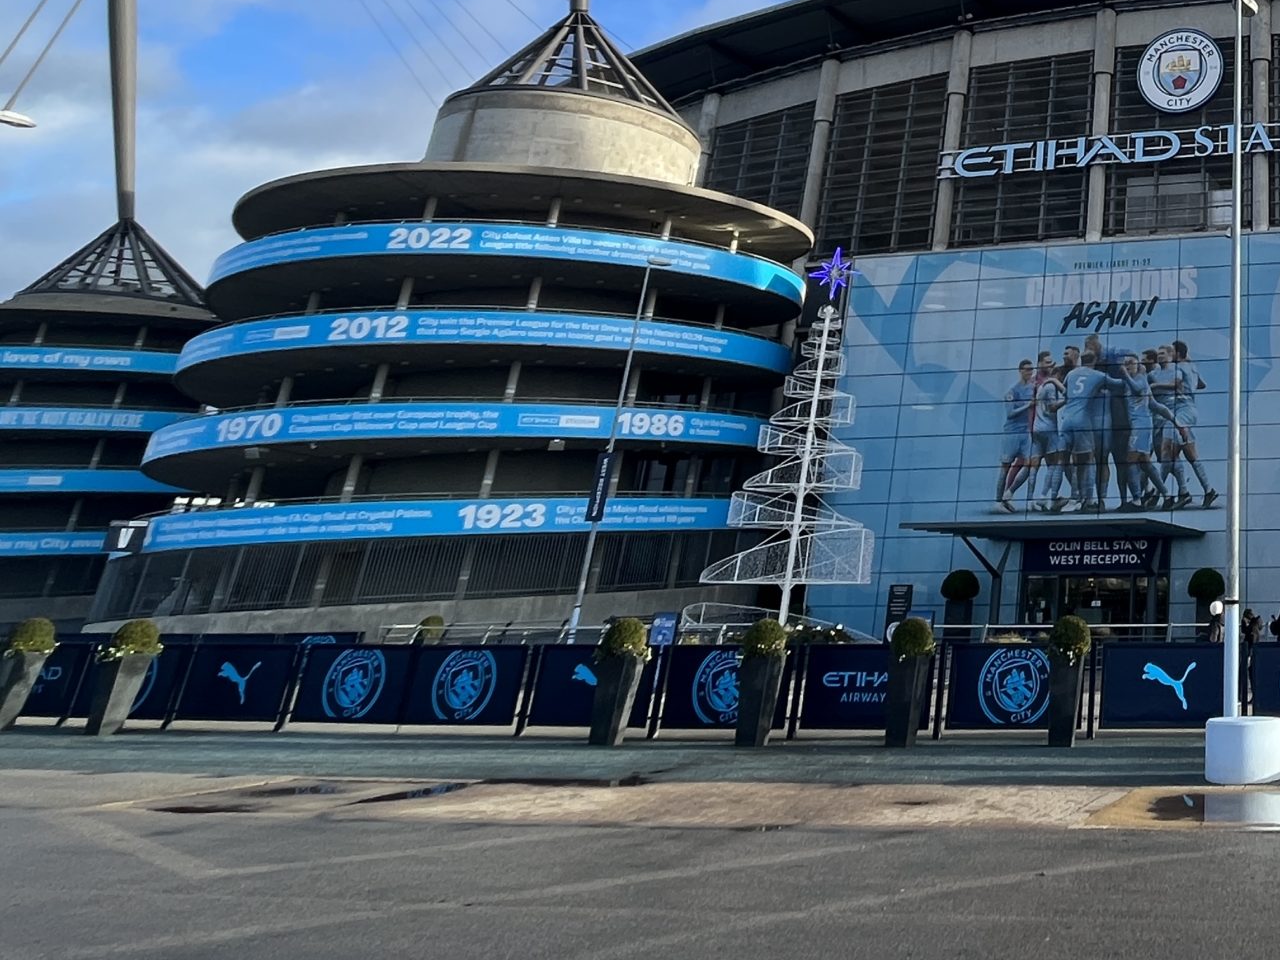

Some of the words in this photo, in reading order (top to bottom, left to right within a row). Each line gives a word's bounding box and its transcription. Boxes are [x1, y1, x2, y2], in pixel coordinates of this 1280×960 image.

[1146, 34, 1215, 63] MANCHESTER
[1166, 97, 1193, 108] CITY
[953, 130, 1181, 178] ETIHAD
[386, 227, 472, 250] 2022
[482, 230, 502, 241] City
[480, 240, 514, 251] League
[1073, 260, 1105, 271] PREMIER
[1025, 266, 1198, 307] CHAMPIONS
[418, 317, 440, 327] City
[1060, 295, 1160, 335] AGAIN!
[327, 315, 410, 341] 2012
[3, 351, 40, 363] love
[42, 351, 63, 363] of
[63, 354, 90, 367] my
[93, 356, 132, 367] own
[1072, 376, 1088, 395] 5
[66, 411, 112, 427] REALLY
[111, 413, 145, 428] HERE
[215, 412, 283, 441] 1970
[476, 419, 498, 431] Cup
[617, 412, 685, 437] 1986
[457, 503, 546, 529] 1923
[555, 505, 577, 516] City
[1049, 541, 1081, 553] COLIN
[1083, 541, 1110, 552] BELL
[1050, 555, 1081, 566] WEST
[1082, 553, 1146, 565] RECEPTIO
[440, 649, 490, 682] MANCHESTER
[700, 650, 739, 683] MANCHE
[984, 648, 1043, 683] MANCHESTER
[823, 671, 888, 688] ETIHA
[840, 691, 887, 704] AIRWAY
[342, 705, 363, 718] CITY
[454, 706, 475, 720] CITY
[1010, 709, 1033, 723] CITY
